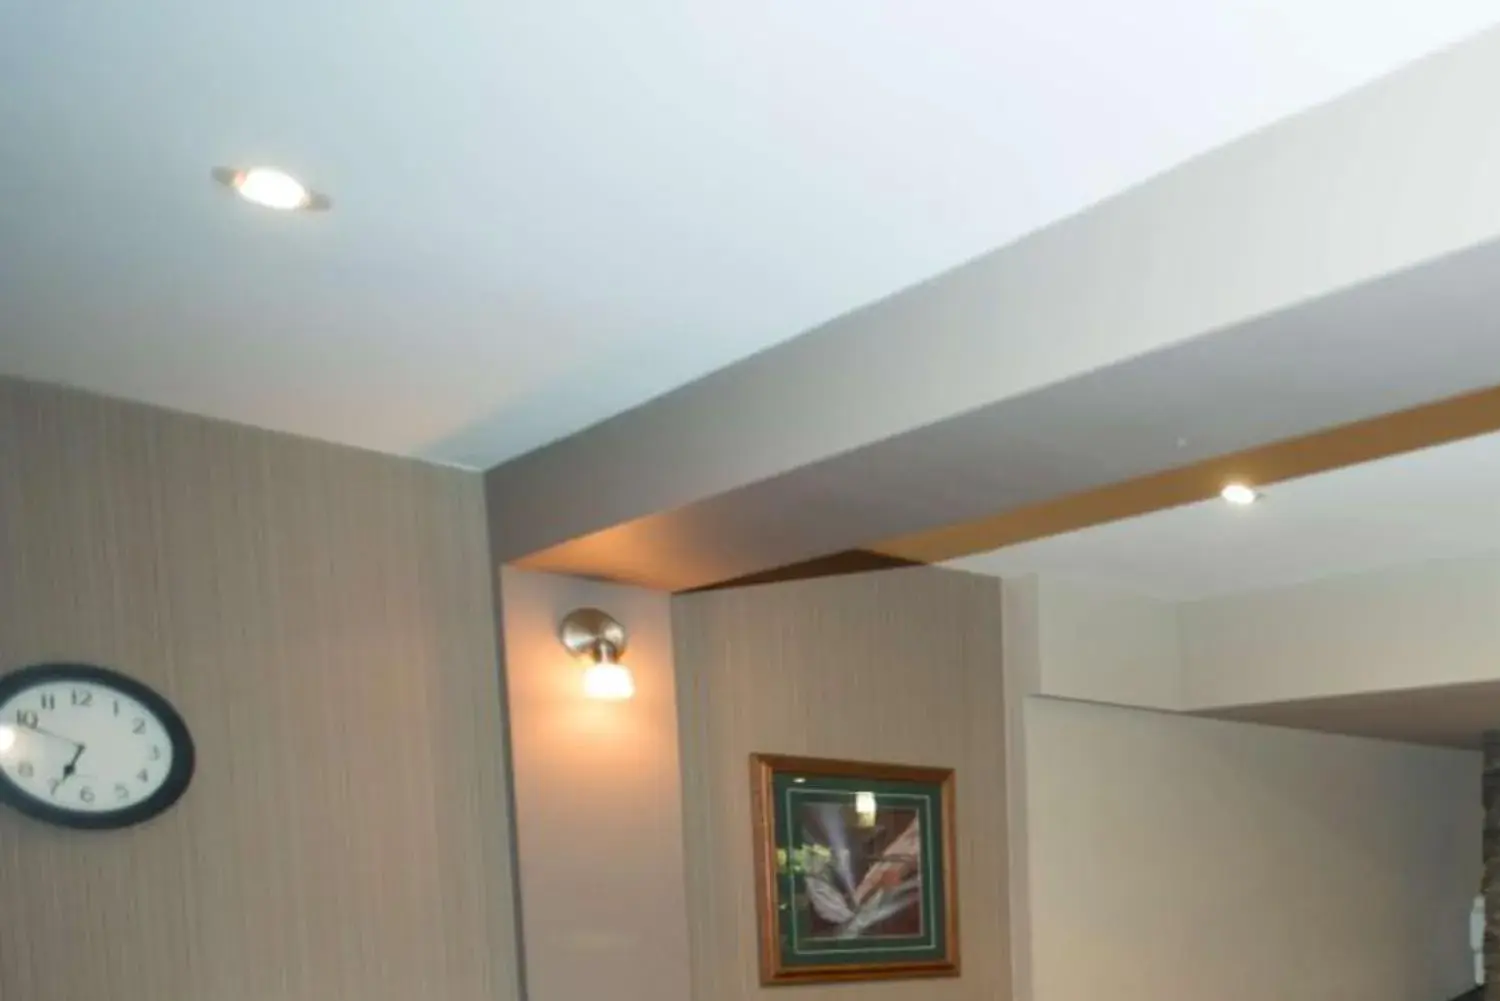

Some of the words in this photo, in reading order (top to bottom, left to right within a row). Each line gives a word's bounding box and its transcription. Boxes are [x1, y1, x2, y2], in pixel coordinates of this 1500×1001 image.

[40, 692, 55, 711] 11
[70, 688, 94, 708] 12
[112, 699, 119, 718] 1
[16, 708, 39, 730] 10
[132, 717, 147, 736] 2
[136, 767, 149, 783] 4
[46, 777, 62, 796] 7
[79, 785, 96, 804] 6
[114, 783, 130, 802] 5
